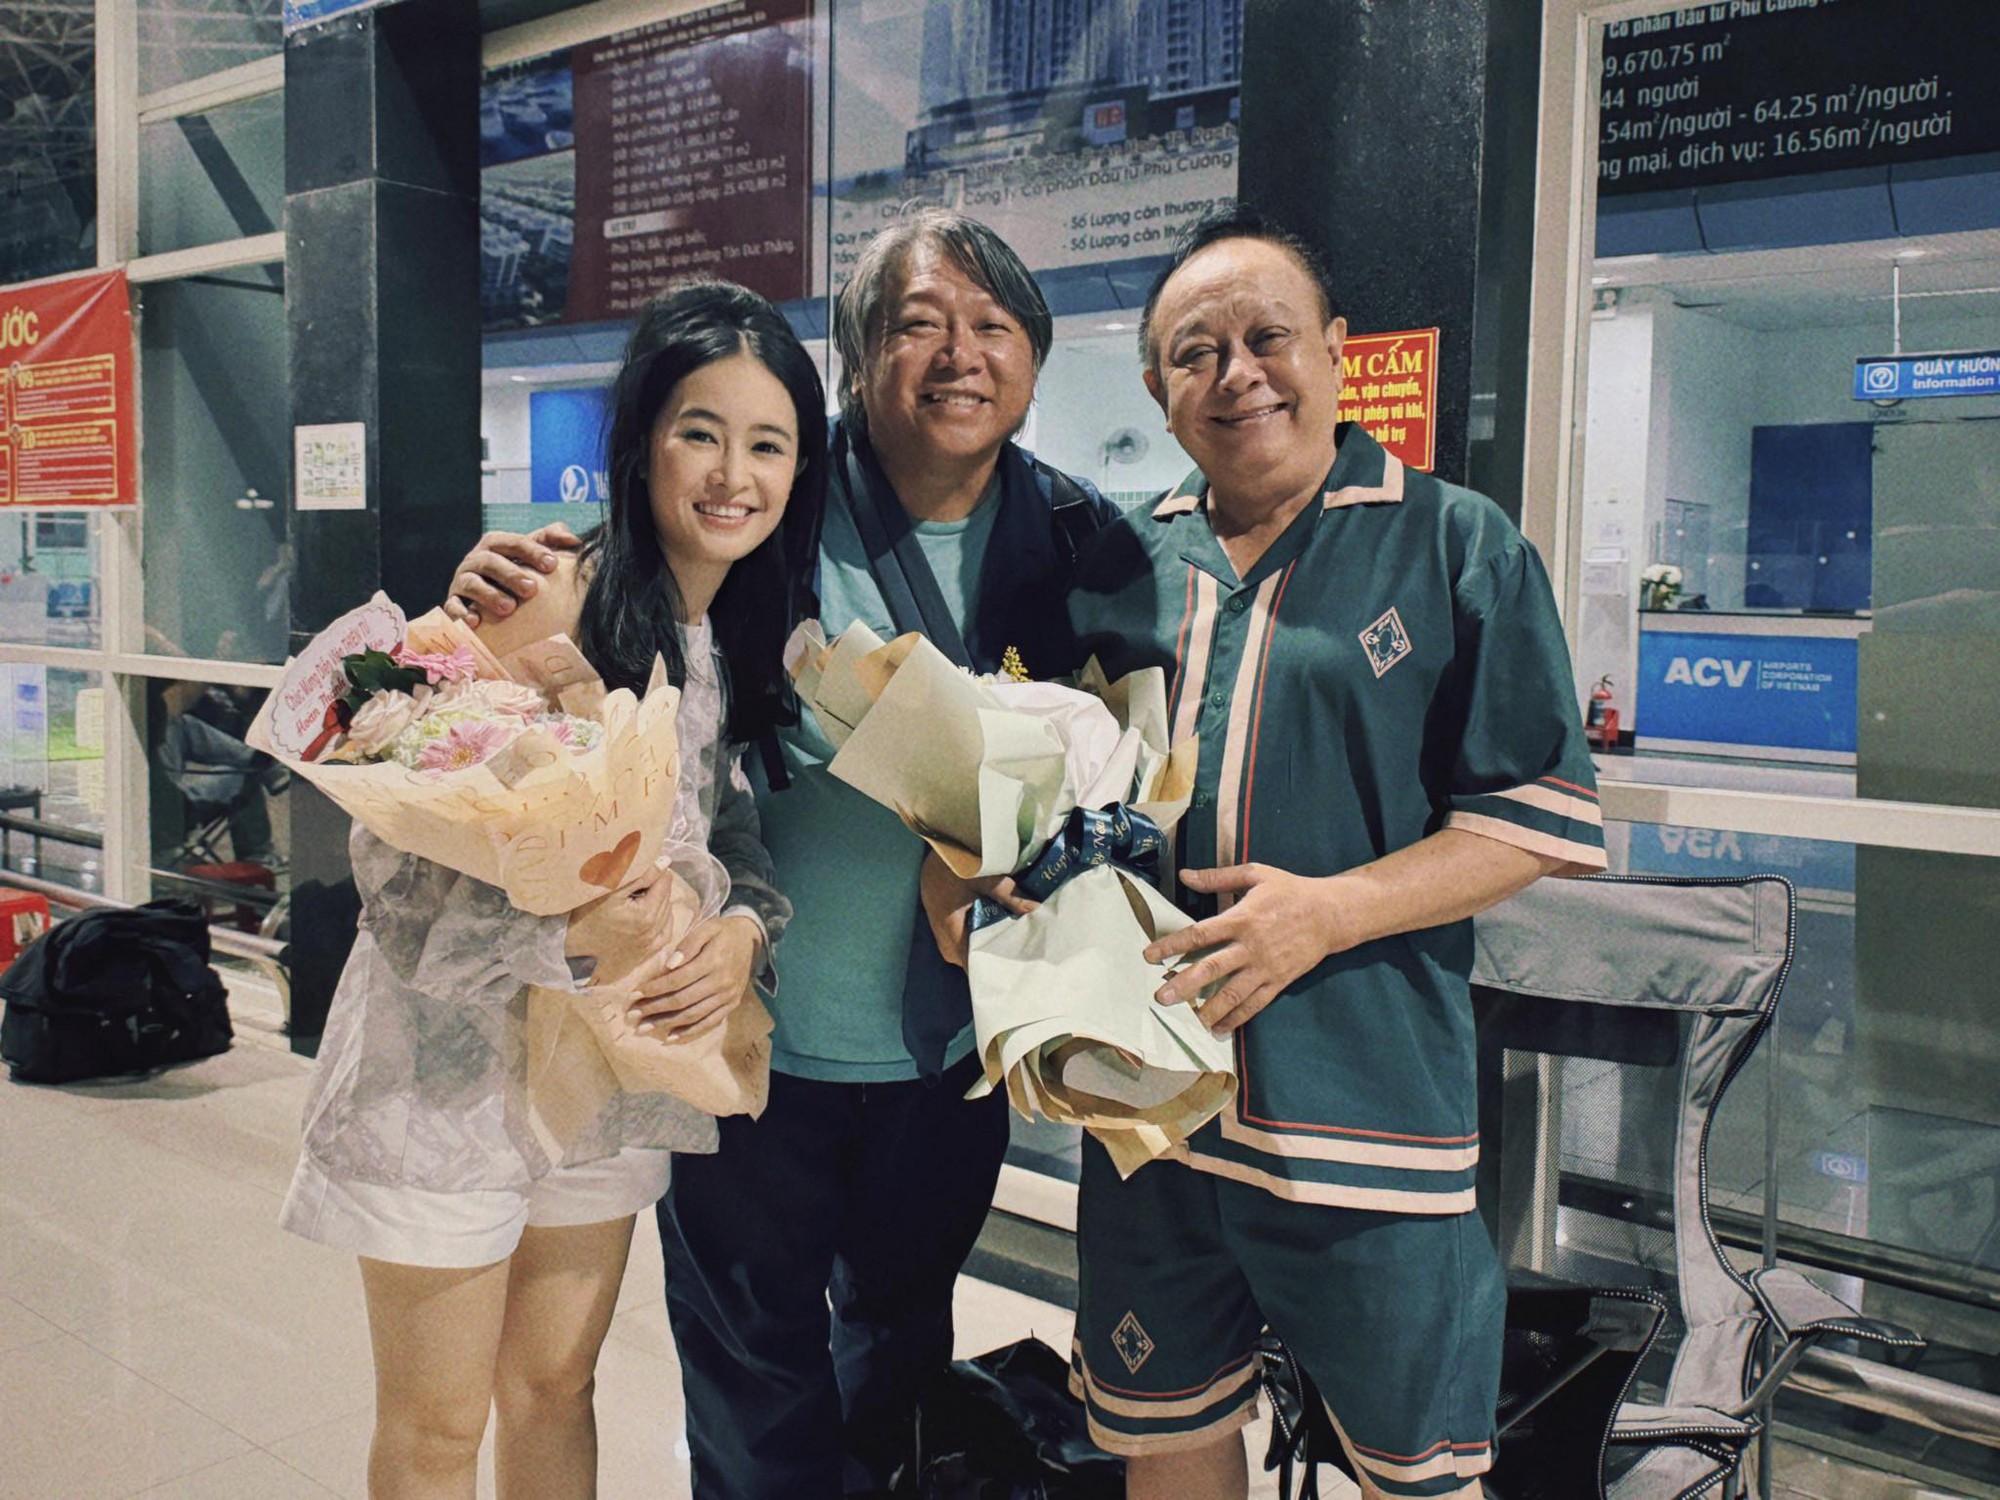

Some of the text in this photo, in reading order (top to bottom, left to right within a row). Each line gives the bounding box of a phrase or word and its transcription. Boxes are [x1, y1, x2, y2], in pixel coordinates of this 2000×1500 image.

[1637, 75, 1700, 108] người
[1754, 92, 1817, 123] 64.25
[1679, 140, 1724, 170] dịch
[1367, 340, 1423, 377] CẤM
[1912, 375, 1994, 390] Information
[1664, 657, 1752, 688] ACV
[1762, 671, 1833, 683] CORPORATION
[1763, 661, 1812, 672] AIRPORTS
[1761, 681, 1821, 692] OF VIETNAM
